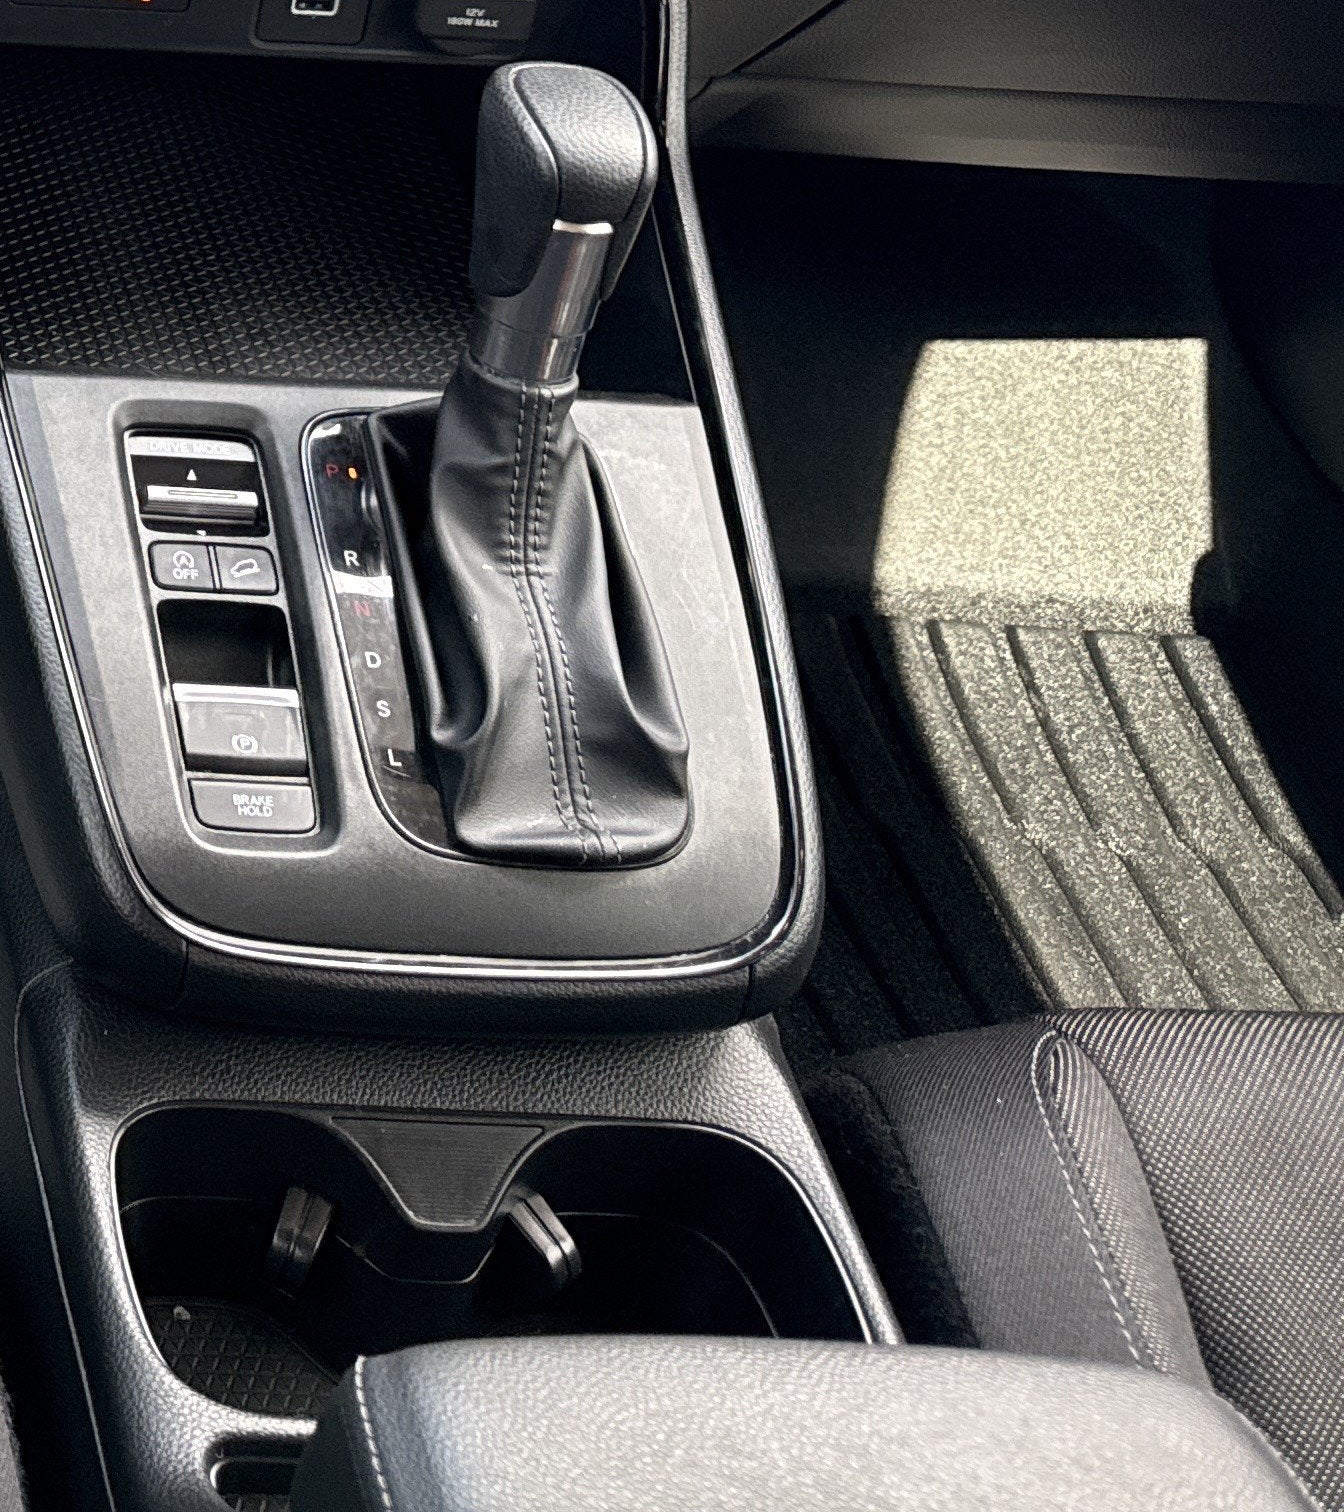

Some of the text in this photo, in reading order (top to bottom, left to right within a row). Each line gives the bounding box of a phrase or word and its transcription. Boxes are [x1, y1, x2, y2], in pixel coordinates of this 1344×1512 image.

[474, 18, 500, 29] MAX
[325, 463, 339, 478] P
[343, 549, 360, 567] R
[172, 568, 199, 581] OFF
[355, 600, 370, 617] N
[364, 651, 382, 668] D
[376, 700, 392, 718] S
[387, 748, 402, 767] L
[232, 793, 274, 806] BRAKE
[238, 804, 273, 817] HOLD
